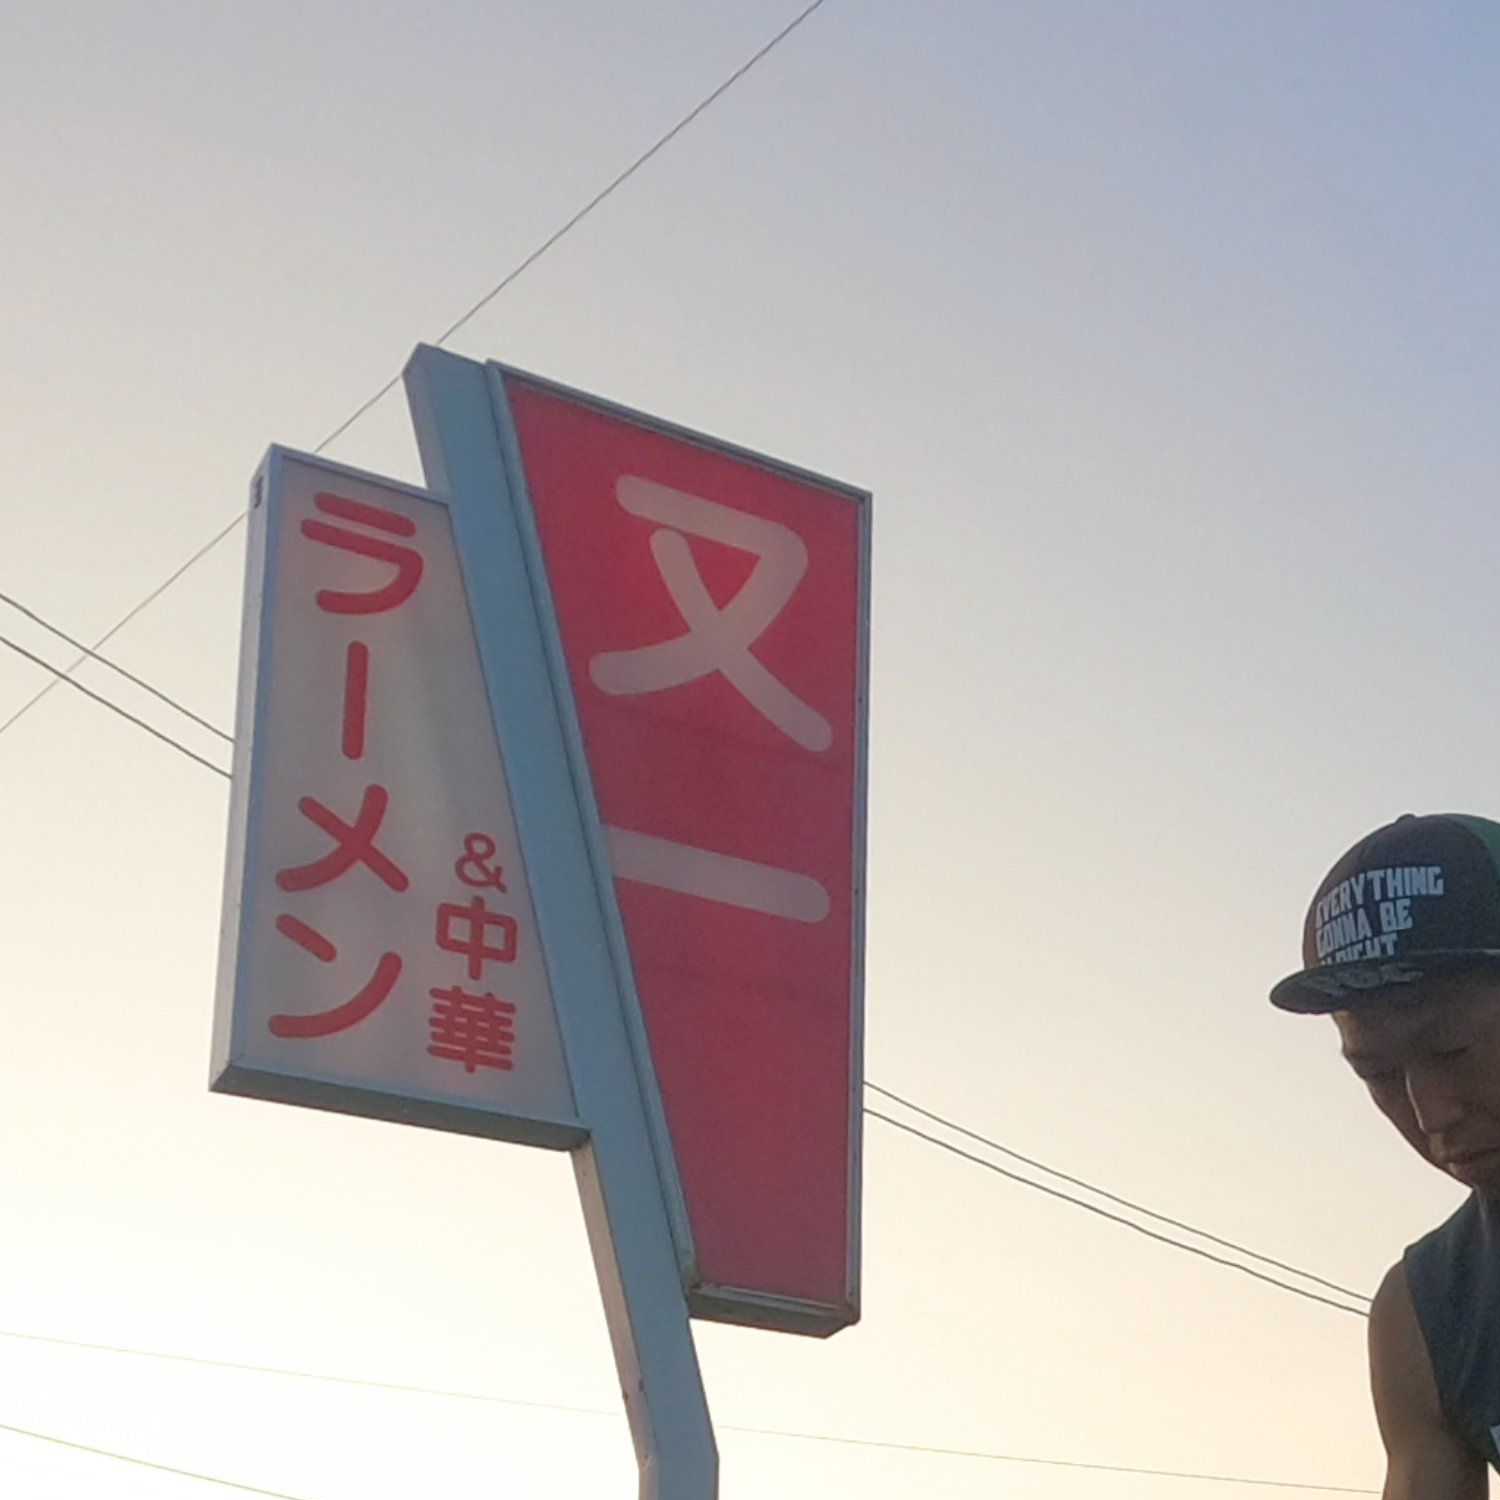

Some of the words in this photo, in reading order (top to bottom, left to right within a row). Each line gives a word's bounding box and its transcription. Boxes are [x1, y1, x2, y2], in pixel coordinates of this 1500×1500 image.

[268, 491, 425, 1040] ラーメン
[588, 473, 834, 923] 又一
[1316, 865, 1444, 930] EVERYTHING
[1316, 907, 1372, 958] GONNA
[1380, 898, 1413, 933] BE
